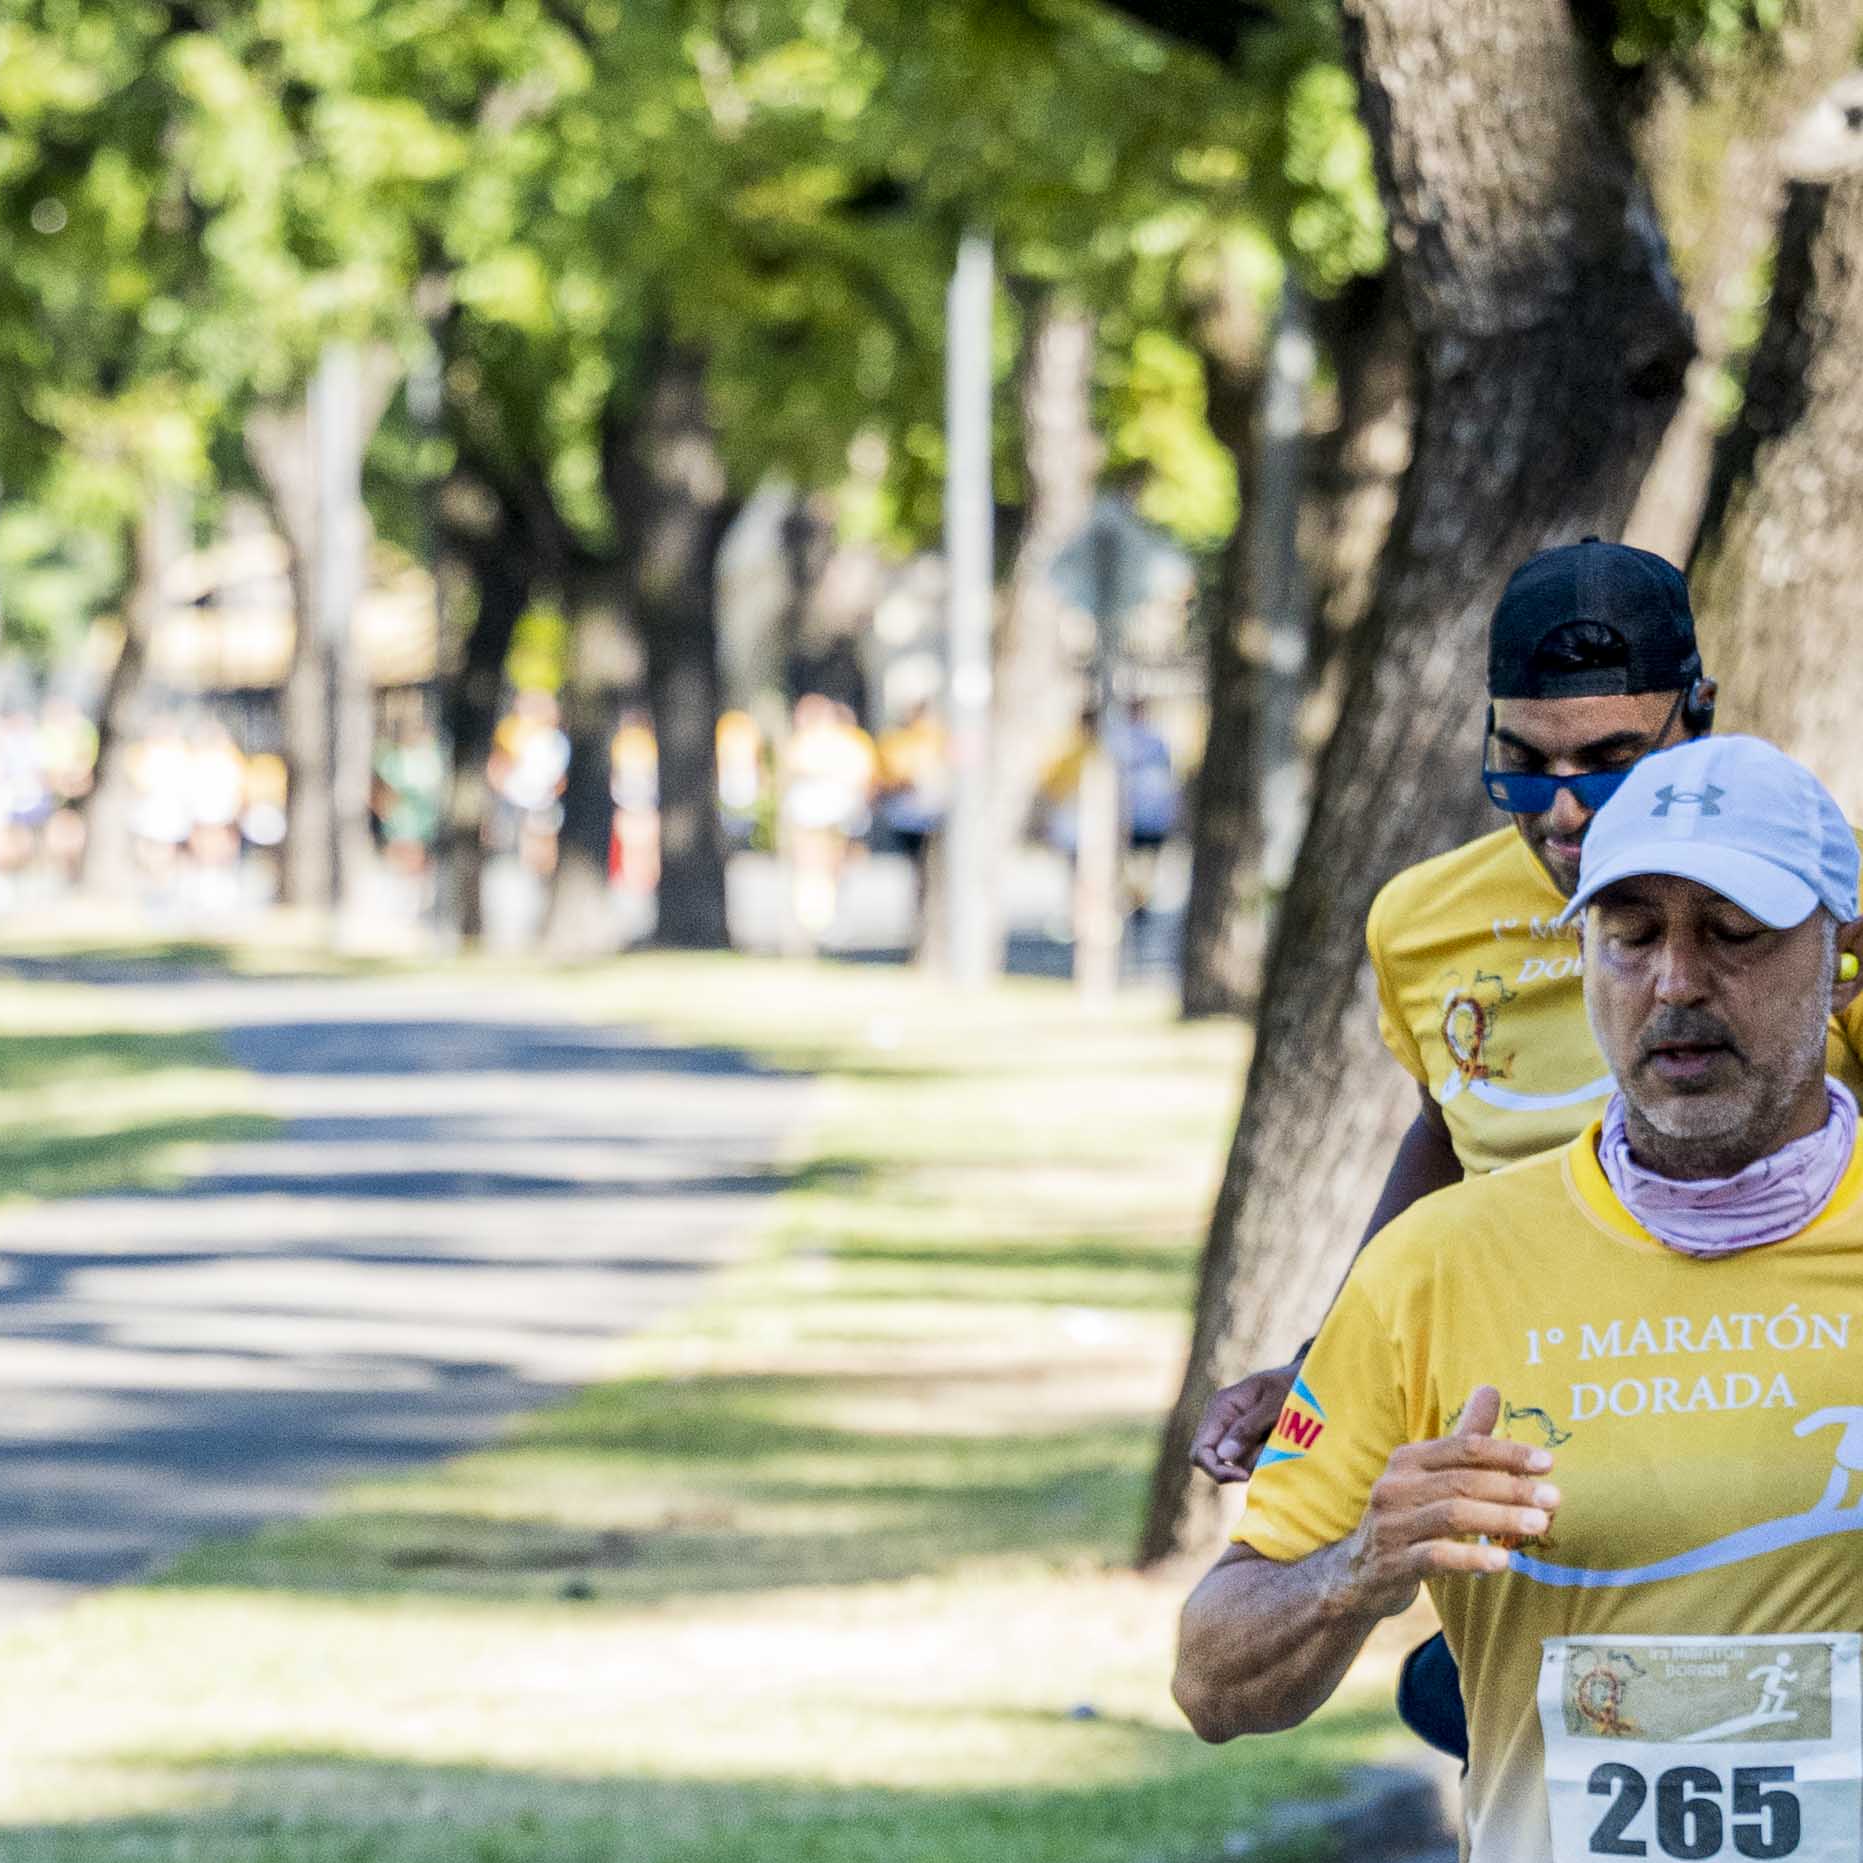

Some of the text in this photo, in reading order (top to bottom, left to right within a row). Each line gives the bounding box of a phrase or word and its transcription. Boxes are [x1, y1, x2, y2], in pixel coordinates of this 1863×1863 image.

[1578, 1303, 1852, 1361] MARATÓN
[1568, 1372, 1799, 1421] DORADA
[1587, 1762, 1801, 1860] 265
